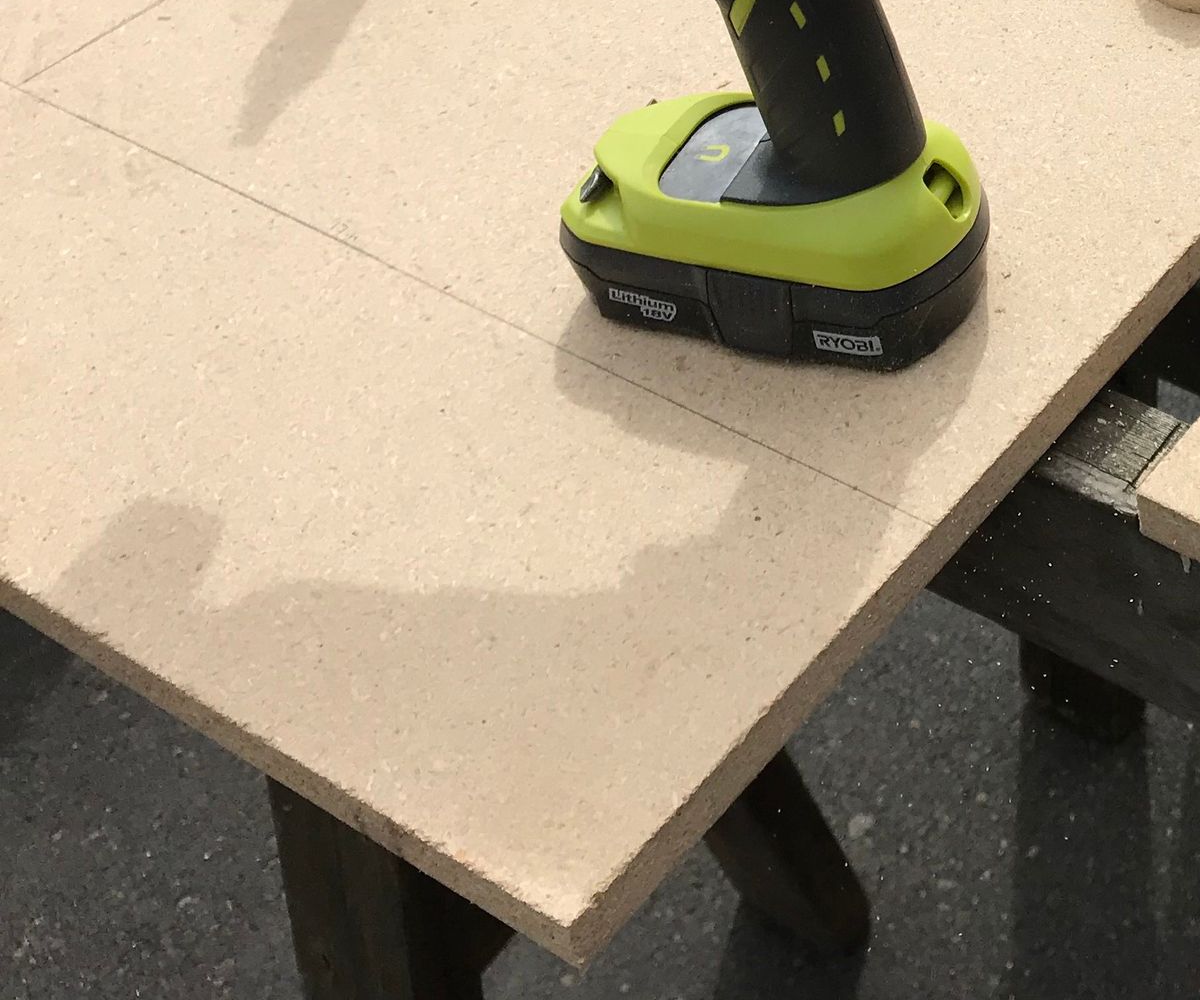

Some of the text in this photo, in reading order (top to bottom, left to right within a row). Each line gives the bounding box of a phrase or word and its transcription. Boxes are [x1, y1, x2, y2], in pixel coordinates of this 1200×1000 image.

[610, 289, 675, 312] Lithium
[643, 308, 673, 320] 18V
[816, 333, 875, 352] RYOBI
